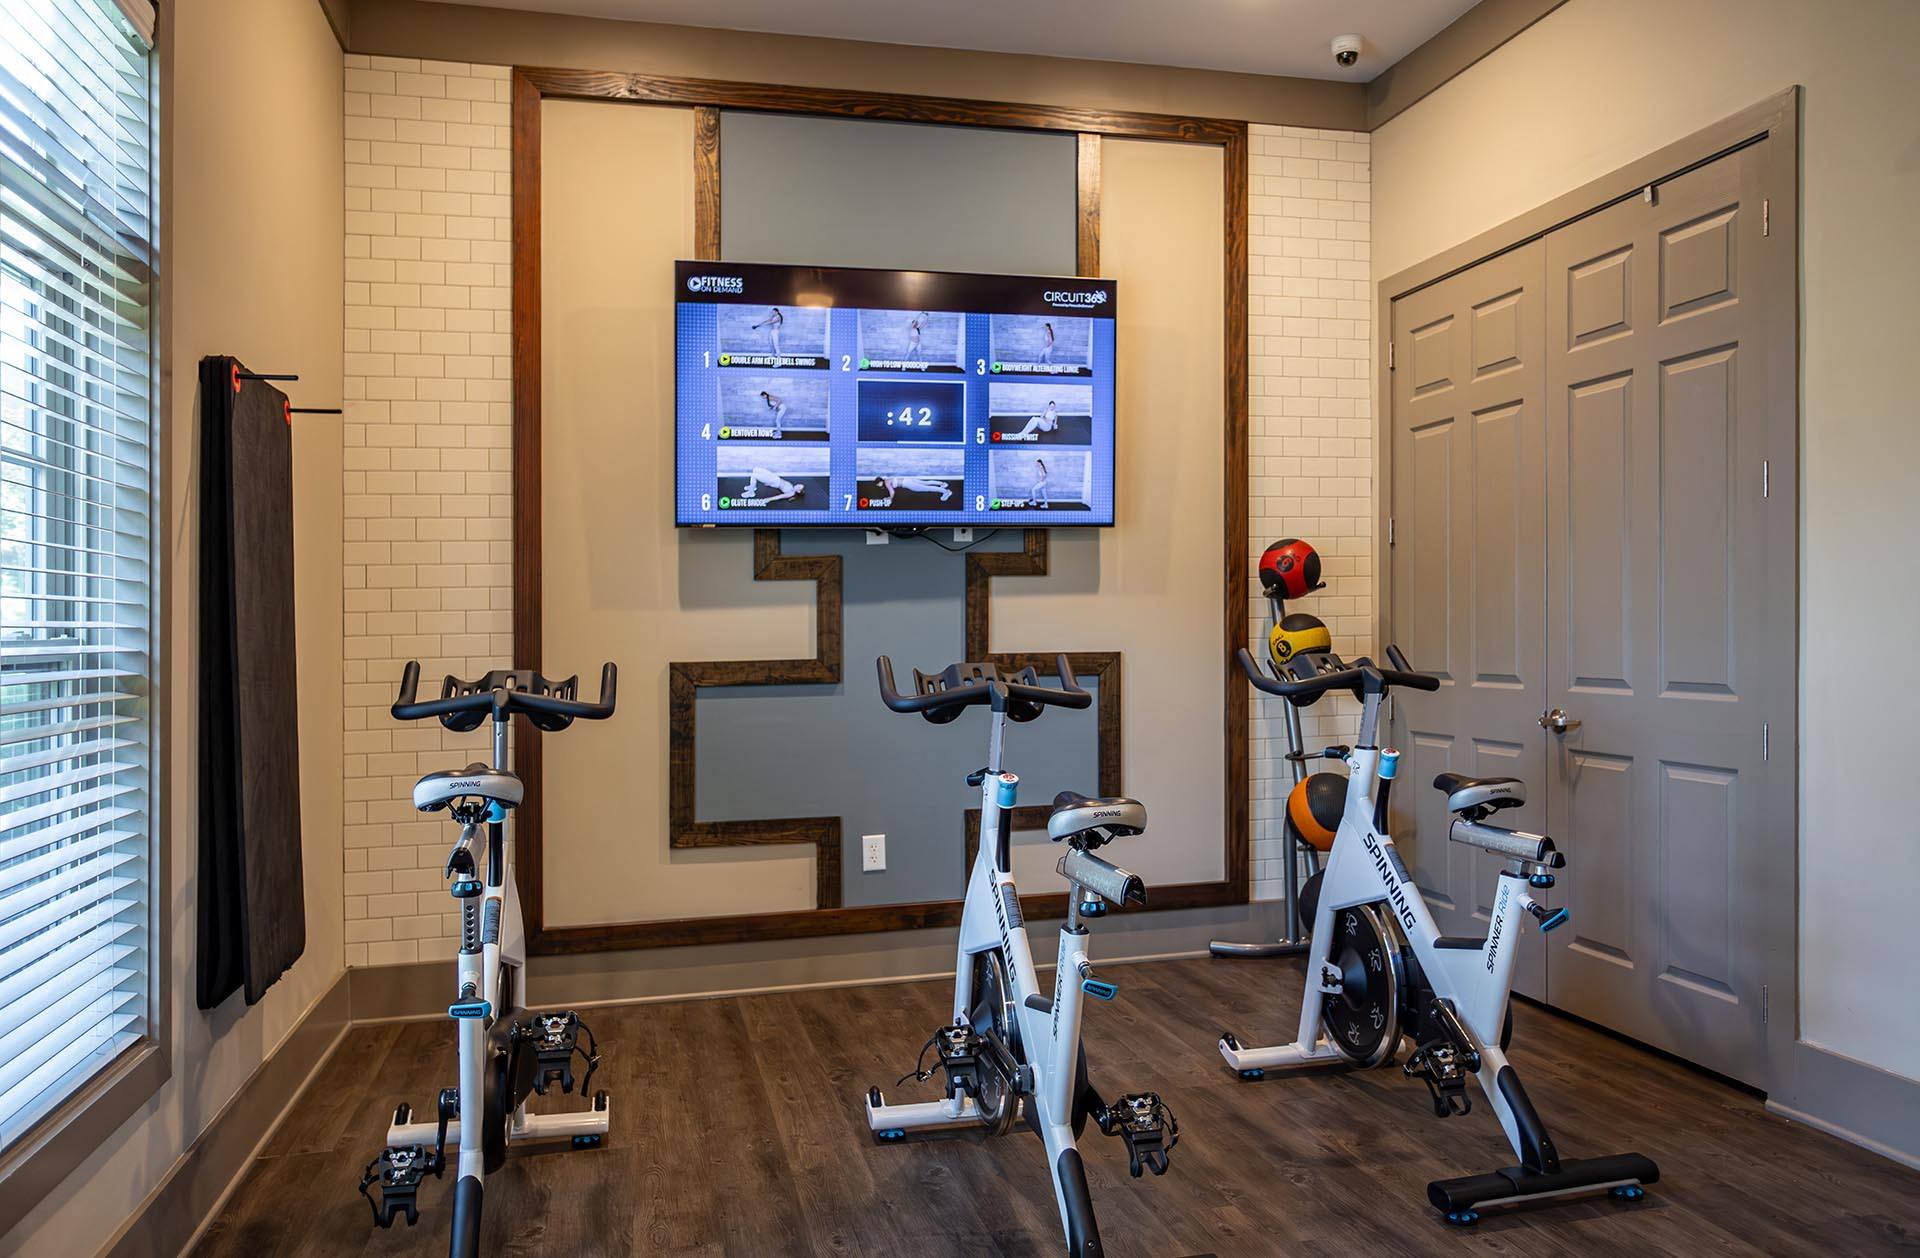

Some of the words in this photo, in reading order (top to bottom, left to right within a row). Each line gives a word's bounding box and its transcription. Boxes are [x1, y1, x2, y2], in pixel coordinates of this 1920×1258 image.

[701, 276, 743, 288] FITNESS
[713, 286, 743, 294] DEMAND
[703, 351, 710, 368] 1
[842, 355, 851, 371] 2
[976, 358, 985, 375] 3
[701, 423, 711, 440] 4
[976, 427, 985, 444] 5
[701, 493, 711, 511] 6
[843, 494, 852, 511] 7
[975, 495, 985, 512] 8
[1277, 642, 1287, 653] 8
[449, 780, 481, 790] SPINNING
[1093, 810, 1121, 819] SPINNING
[1362, 832, 1417, 930] SPINNING
[988, 868, 1018, 984] SPINNING
[1486, 913, 1504, 974] SPINNER
[1052, 973, 1063, 1042] SPINNER
